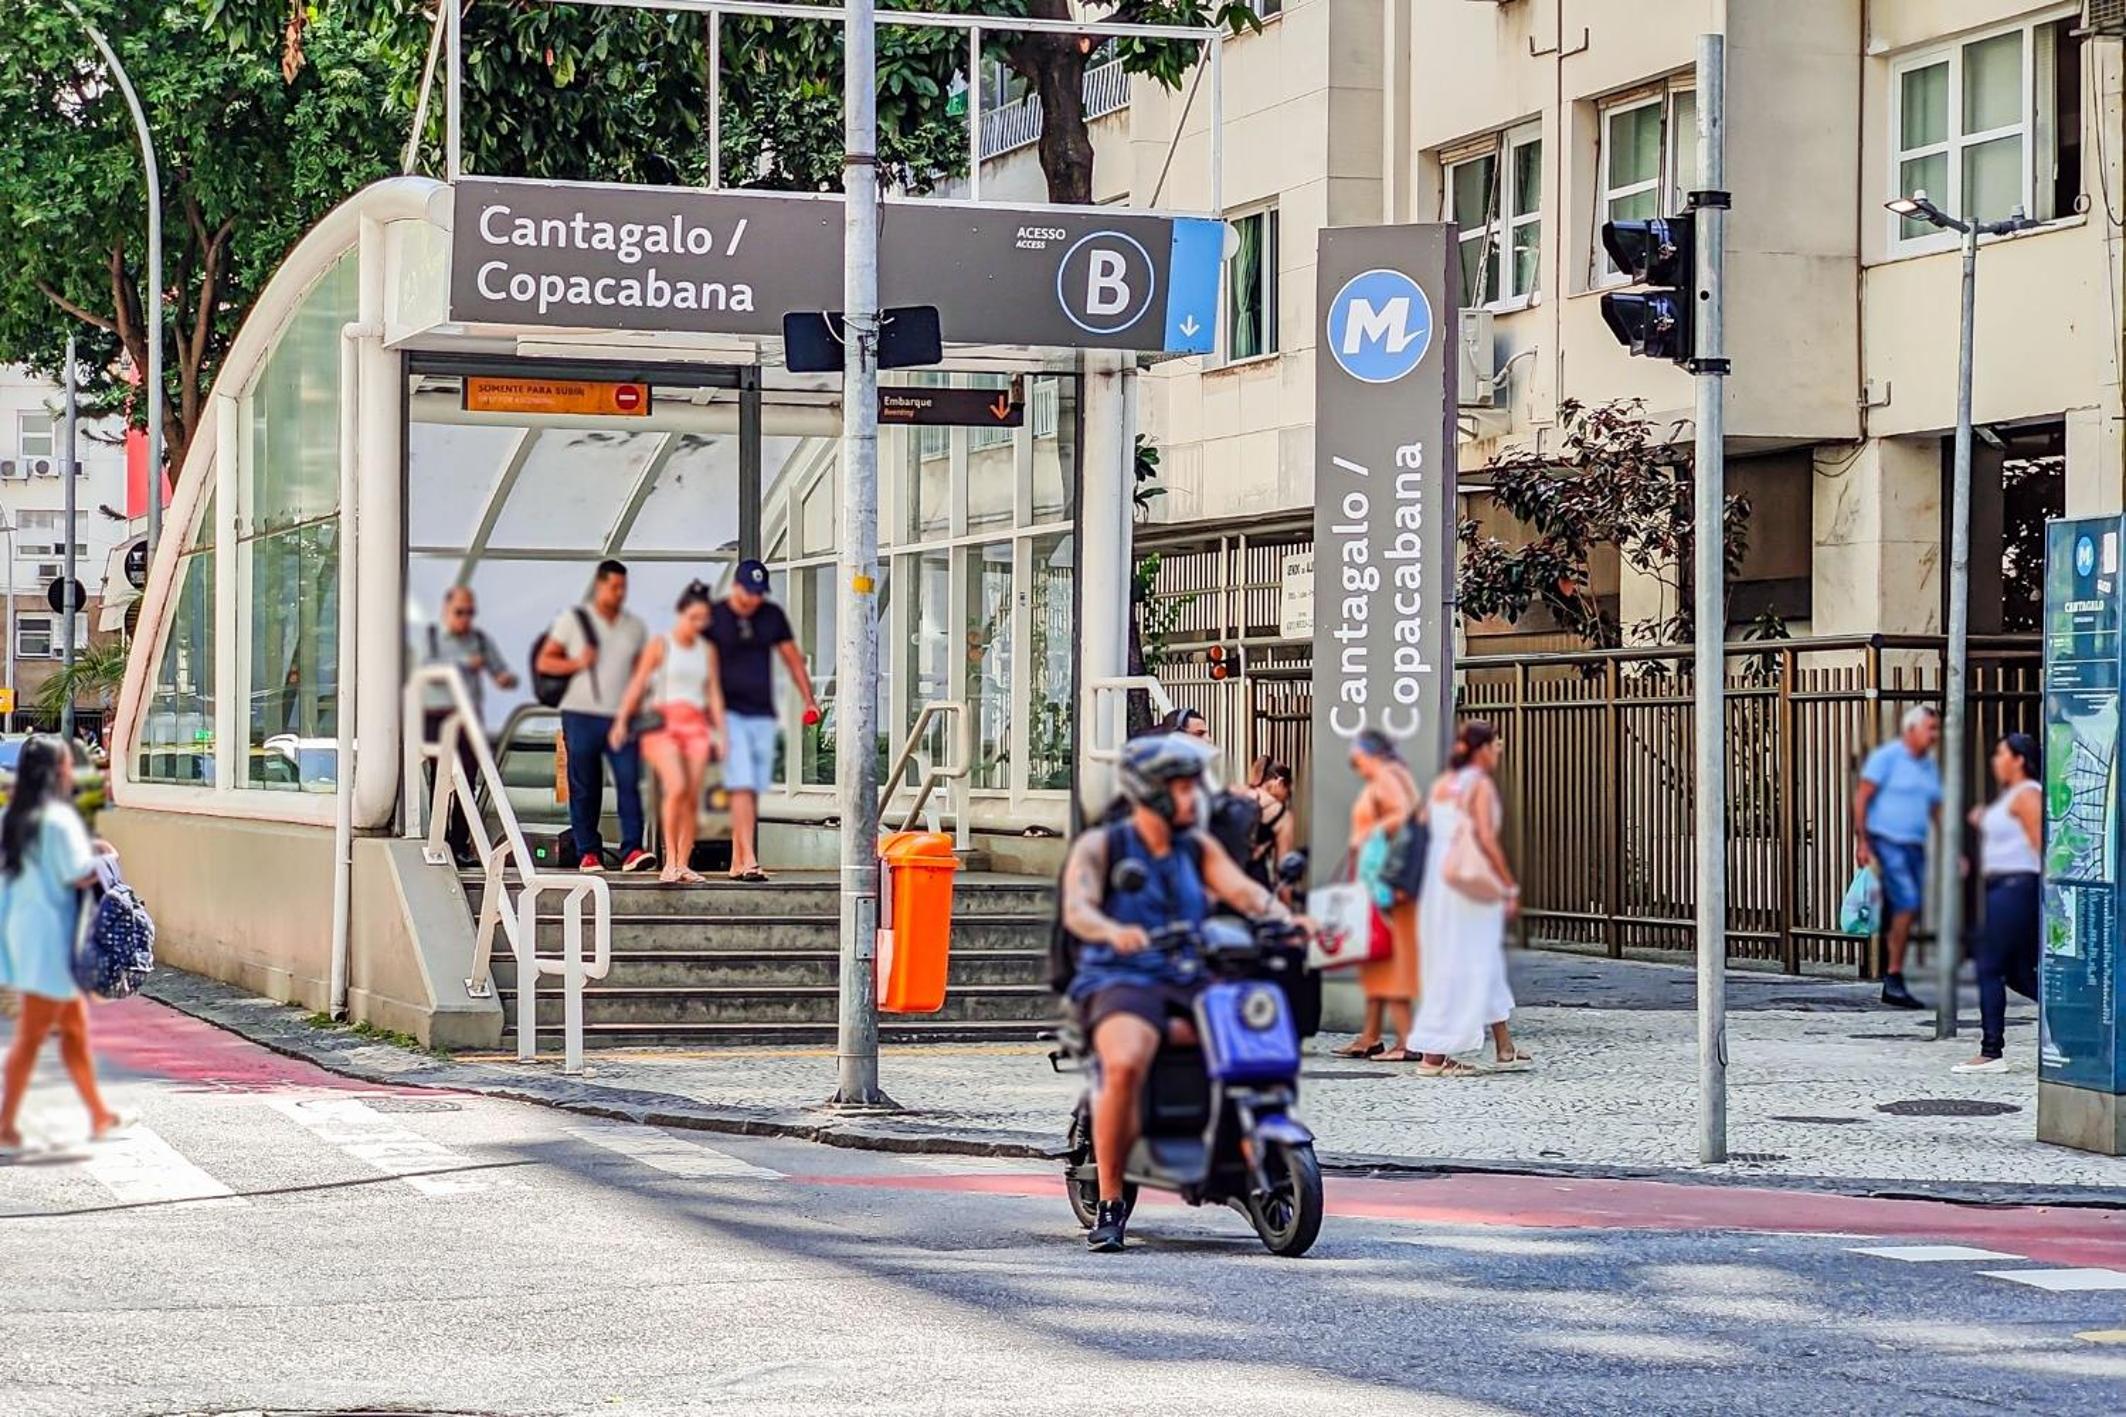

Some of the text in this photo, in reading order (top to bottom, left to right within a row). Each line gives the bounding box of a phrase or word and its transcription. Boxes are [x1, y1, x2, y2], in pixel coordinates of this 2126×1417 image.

[479, 205, 748, 263] Cantagalo /
[1016, 227, 1067, 241] ACESSO
[1016, 240, 1047, 249] ACCESS
[477, 261, 754, 315] Copacabana
[1086, 249, 1131, 316] B
[478, 384, 525, 394] SOMENTE
[526, 386, 552, 395] PARA
[883, 396, 933, 409] Embarque
[1330, 454, 1380, 738] Cantagalo /
[1381, 441, 1432, 739] Copacabana
